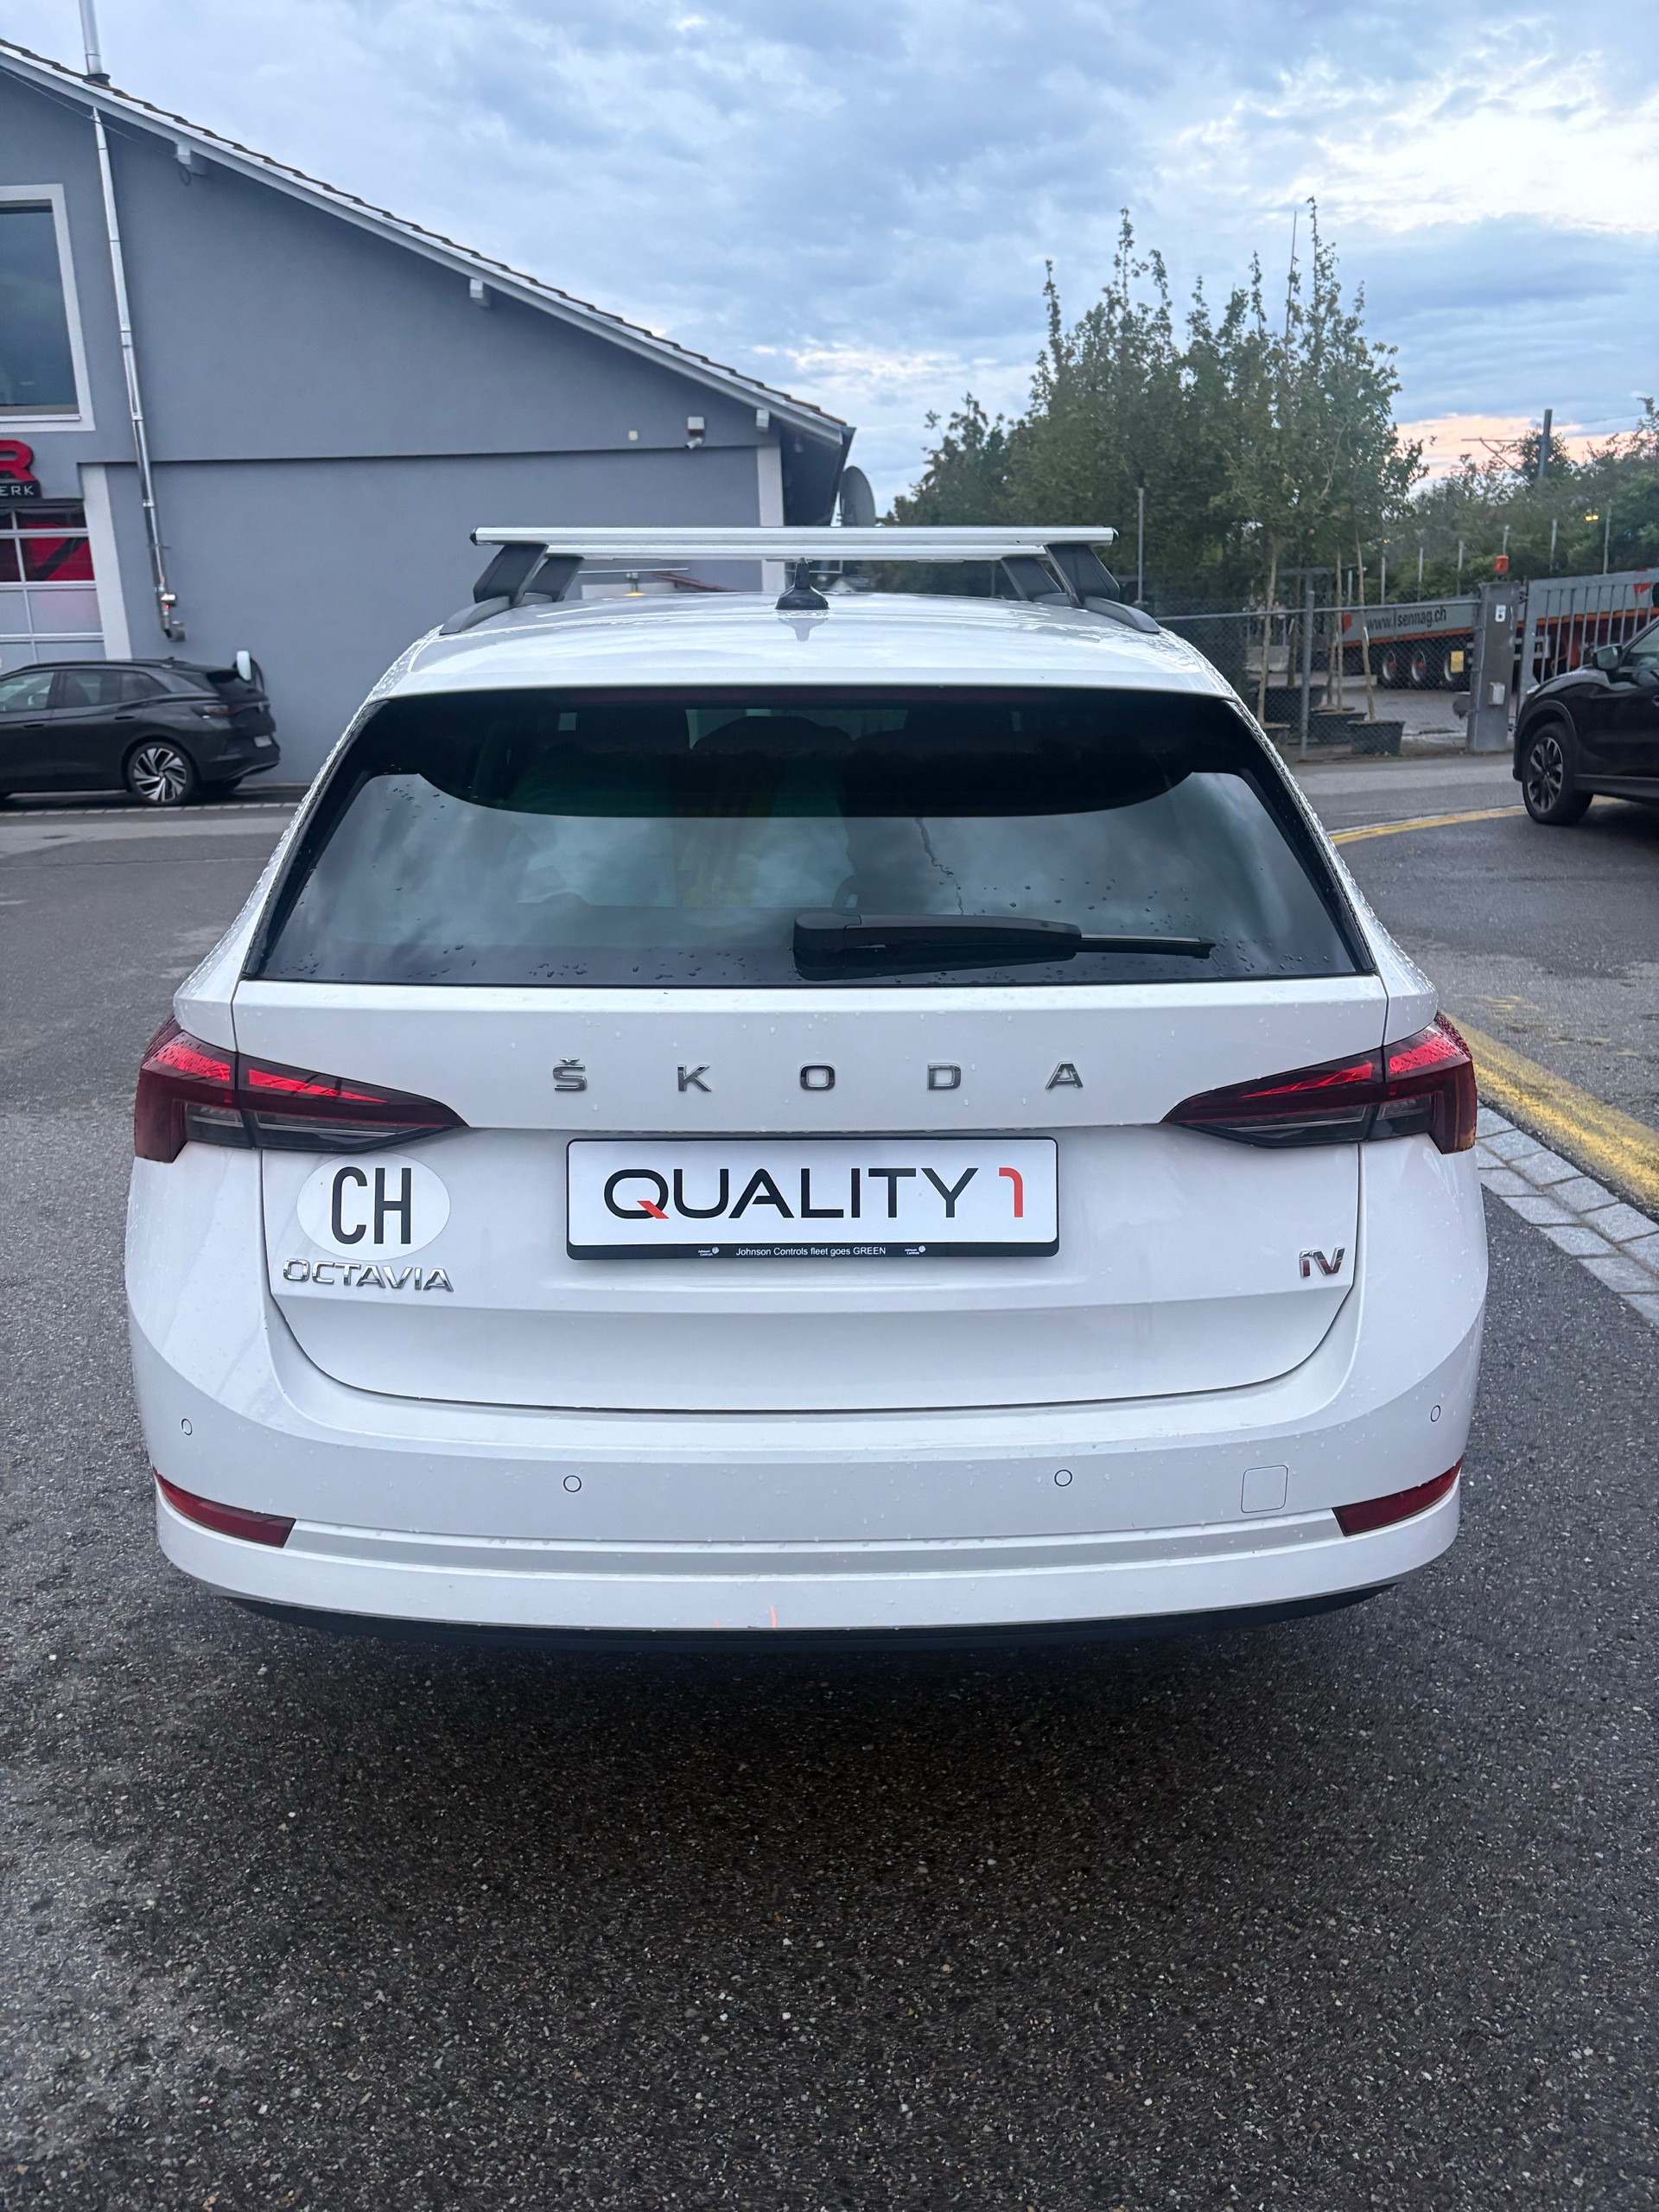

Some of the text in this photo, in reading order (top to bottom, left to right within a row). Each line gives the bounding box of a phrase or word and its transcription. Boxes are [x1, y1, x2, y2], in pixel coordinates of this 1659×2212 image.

[552, 1057, 1084, 1093] ŠKODA
[331, 1166, 412, 1245] CH
[603, 1166, 1024, 1220] QUALITY 1
[735, 1246, 887, 1257] Johnson Controls fleet goes GREEN
[283, 1258, 454, 1293] OCTAVIA
